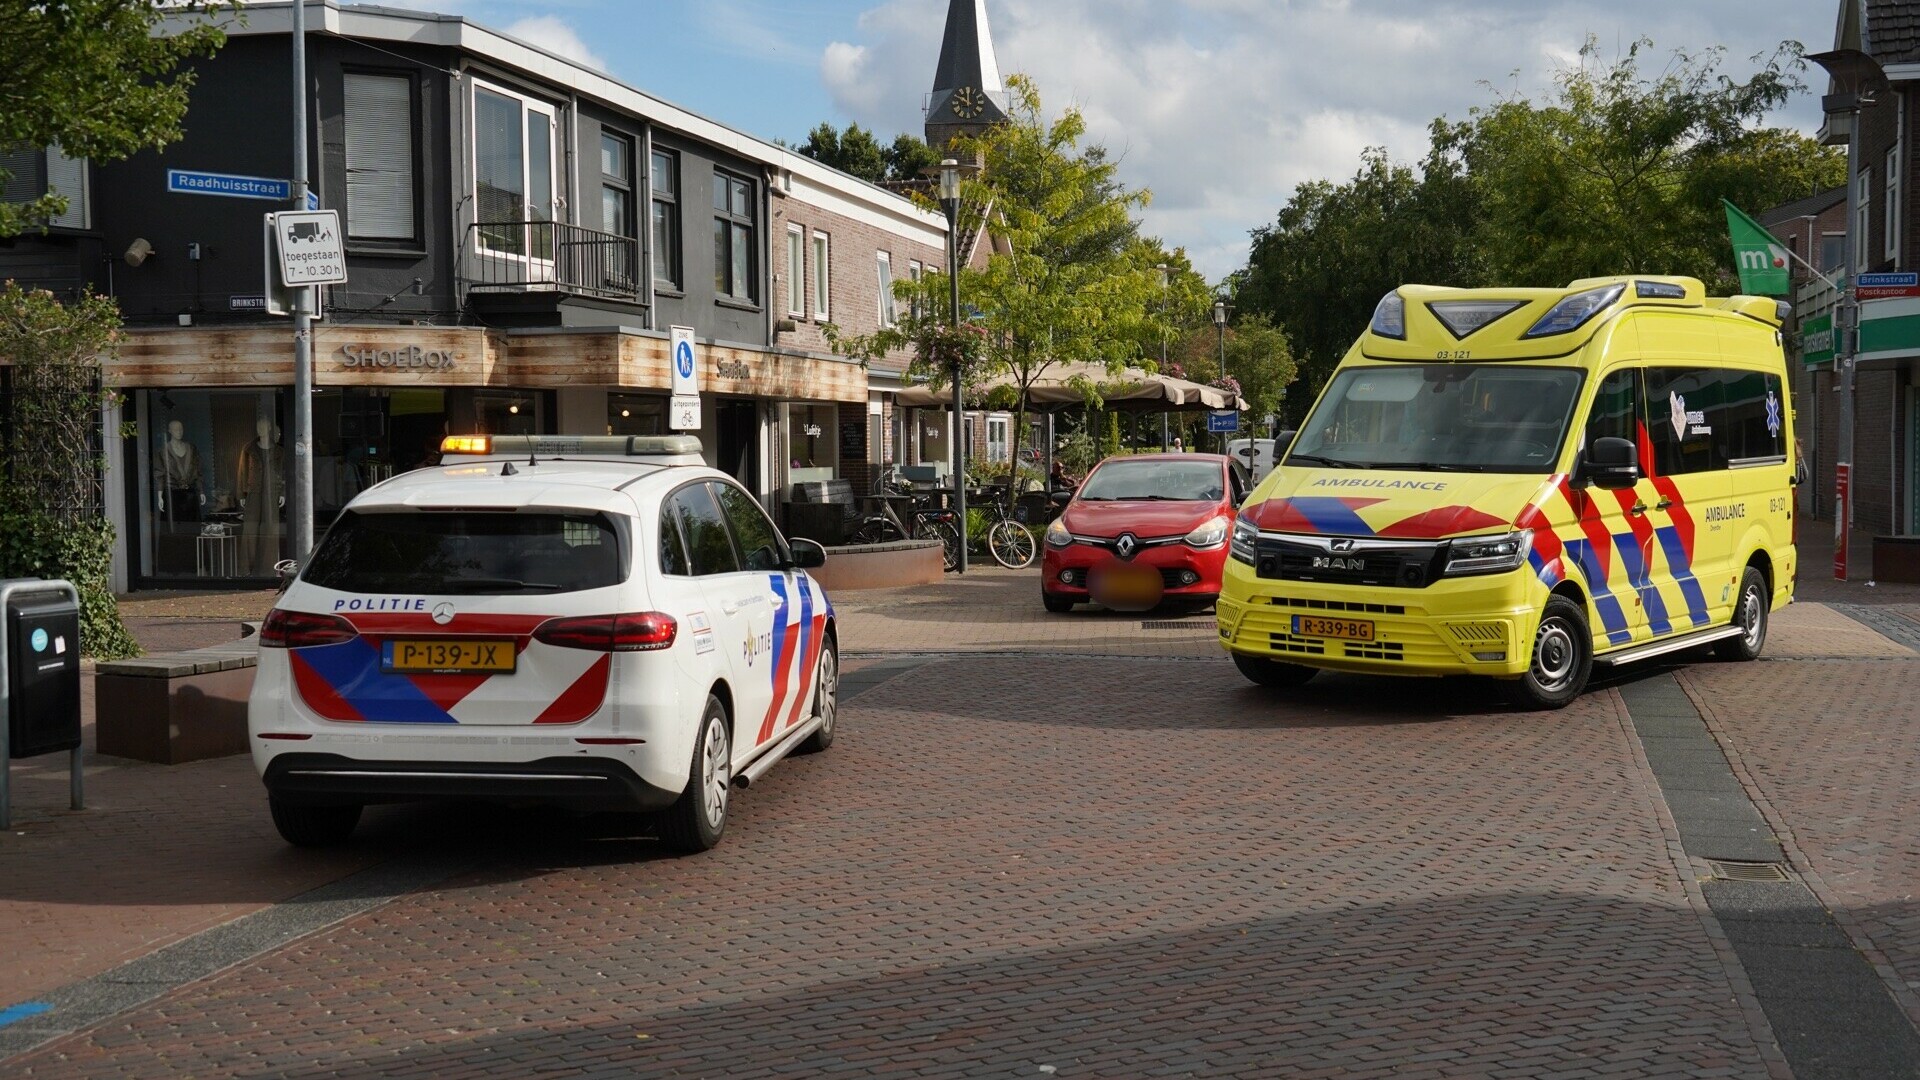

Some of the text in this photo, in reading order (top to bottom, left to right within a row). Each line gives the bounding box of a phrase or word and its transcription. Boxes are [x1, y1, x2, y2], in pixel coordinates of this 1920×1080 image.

[178, 175, 282, 195] Raadhuisstraat
[286, 251, 340, 263] toegestaan
[288, 267, 296, 277] 7
[306, 265, 332, 276] 10.30
[334, 265, 341, 274] h
[1861, 275, 1913, 284] Brinkstraat
[1859, 287, 1908, 296] Postkantoor
[232, 298, 266, 307] BRINKSTR
[1436, 350, 1471, 360] 03-121
[1312, 478, 1448, 491] AMBULANCE
[1769, 497, 1786, 513] 03-121
[1705, 503, 1745, 523] AMBULANCE
[1312, 556, 1365, 571] MAN
[334, 599, 425, 611] POLITIE
[1304, 619, 1368, 638] R-339-BG
[383, 645, 497, 666] NL P-139-JX
